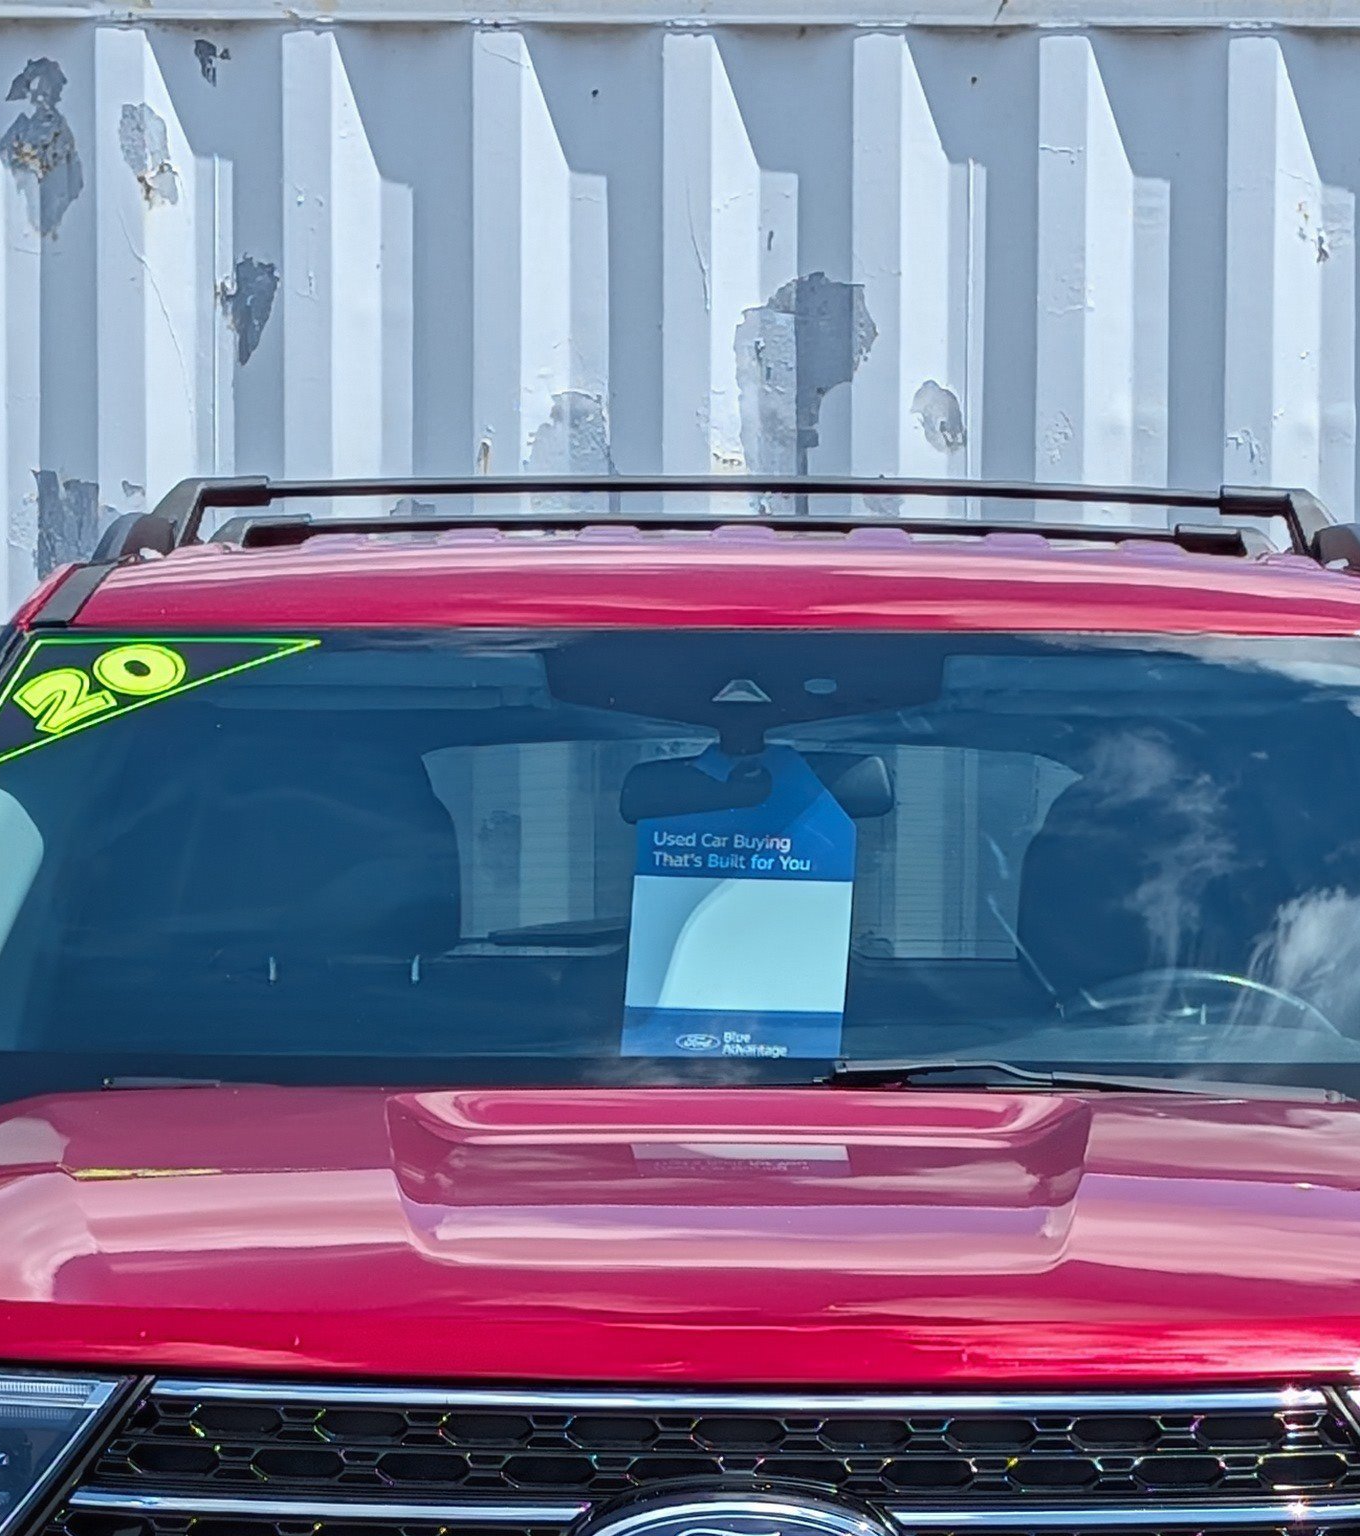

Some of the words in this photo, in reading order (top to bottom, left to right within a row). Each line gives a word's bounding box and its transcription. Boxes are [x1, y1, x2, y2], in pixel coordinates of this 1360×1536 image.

[12, 643, 186, 734] 20
[653, 831, 696, 847] Used
[701, 833, 728, 848] Car
[734, 834, 792, 853] Buying
[653, 851, 703, 868] That's
[707, 853, 746, 869] Built
[751, 854, 775, 870] for
[779, 855, 811, 871] You
